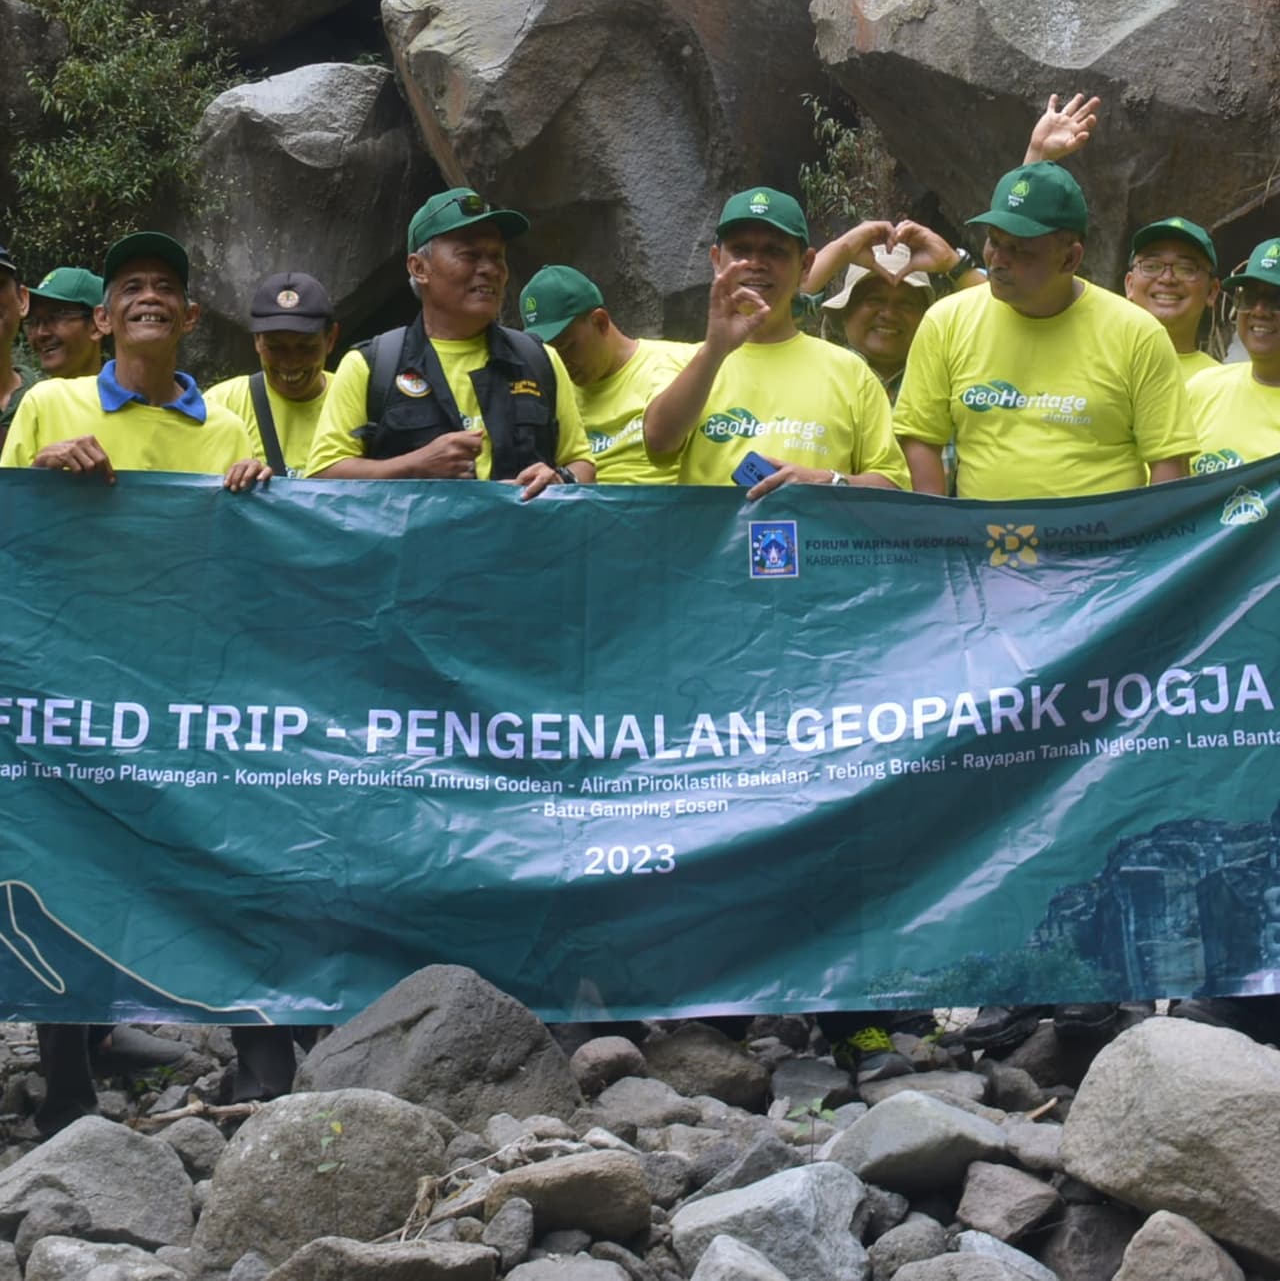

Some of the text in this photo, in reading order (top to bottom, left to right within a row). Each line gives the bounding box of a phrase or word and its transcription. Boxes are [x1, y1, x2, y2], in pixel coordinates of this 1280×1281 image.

[962, 388, 1087, 413] GeoHeritage
[704, 415, 825, 439] GeoHeritage
[1043, 520, 1109, 537] DANA
[805, 539, 849, 551] FORUM
[806, 554, 869, 567] KABUPATEN
[168, 703, 309, 751] TRIP
[366, 708, 767, 760] PENGENALAN
[785, 682, 1067, 753] GEOPARK
[1081, 664, 1275, 724] JOGJA
[32, 761, 61, 779] Tua
[67, 763, 115, 783] Turgo
[120, 765, 217, 787] Plawangan
[235, 769, 322, 787] Kompleks
[328, 769, 424, 788] Perbukitan
[430, 773, 489, 791] Intrusi
[495, 776, 562, 793] Godean
[580, 776, 632, 793] Aliran
[638, 771, 733, 792] Piroklastik
[738, 769, 809, 787] Bakalan
[826, 762, 886, 781] Tebing
[890, 755, 945, 775] Breksi
[963, 747, 1036, 772] Rayapan
[1040, 741, 1090, 760] Tanah
[1095, 736, 1169, 756] Nglepen
[1187, 732, 1228, 749] Lava
[544, 802, 585, 817] Batu
[590, 800, 671, 819] Gamping
[675, 797, 729, 815] Eosen
[583, 844, 676, 875] 2023
